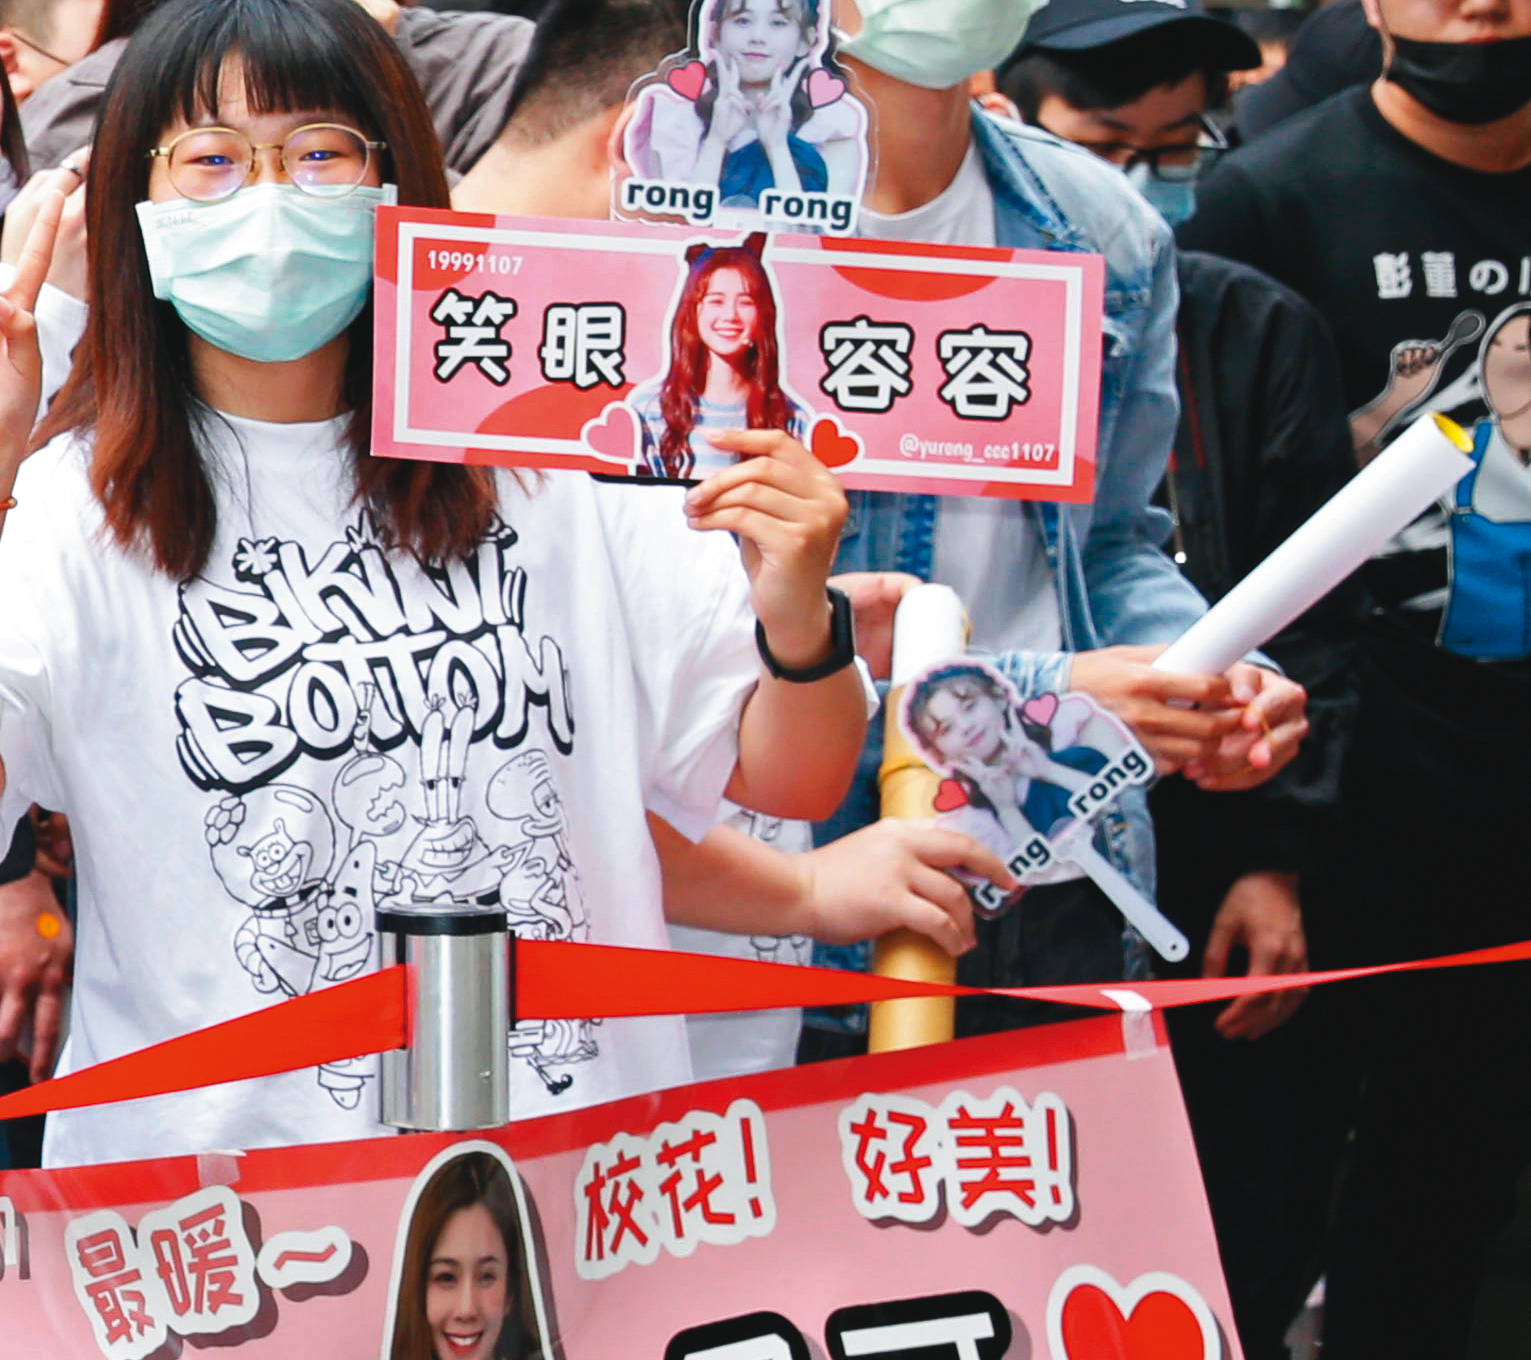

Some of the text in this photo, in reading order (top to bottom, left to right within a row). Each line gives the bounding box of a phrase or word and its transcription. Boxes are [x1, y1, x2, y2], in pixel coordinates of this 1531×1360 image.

[627, 182, 716, 219] rong
[765, 192, 854, 231] rong
[426, 250, 524, 277] 19991107
[430, 288, 1033, 423] 笑眼 容容
[898, 434, 1056, 466] @yurong_ccc1107
[174, 623, 578, 795] BOTTOM
[1069, 747, 1151, 819] rong
[977, 835, 1051, 911] rng
[580, 1093, 1074, 1257] 校花! 好美!
